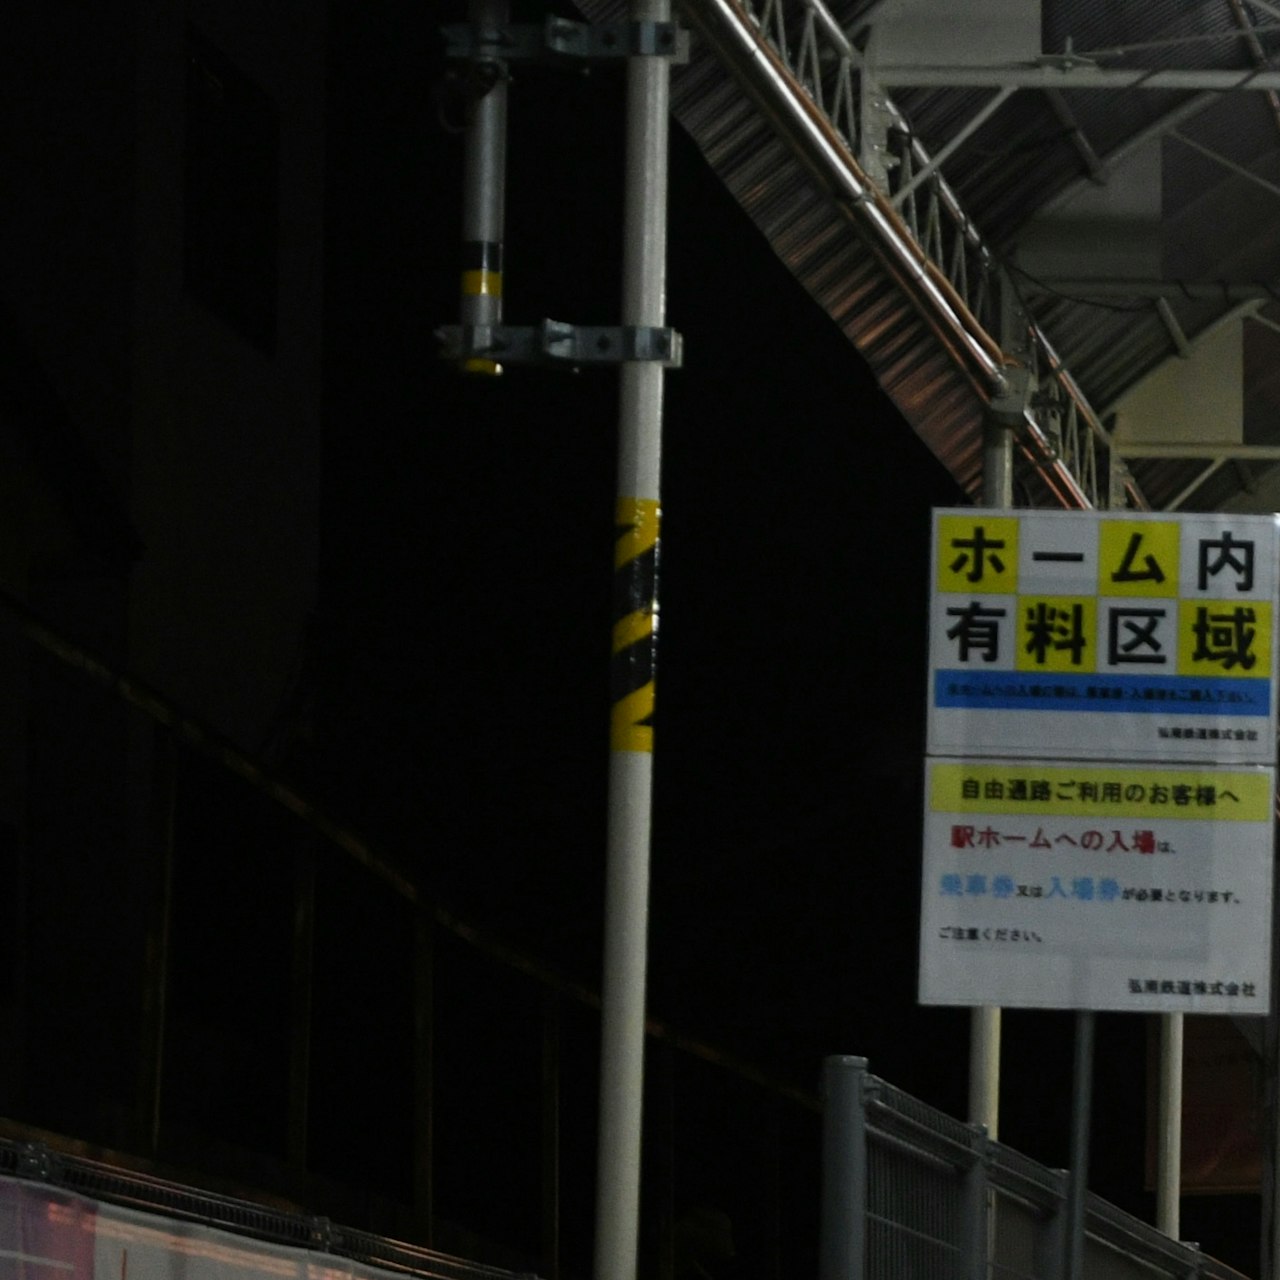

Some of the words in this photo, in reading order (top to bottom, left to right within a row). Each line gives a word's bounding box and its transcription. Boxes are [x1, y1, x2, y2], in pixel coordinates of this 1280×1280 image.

[950, 526, 1255, 592] ホーム内
[946, 601, 1258, 670] 有料区域
[961, 777, 1241, 807] 自由通路ご利用のお客様へ
